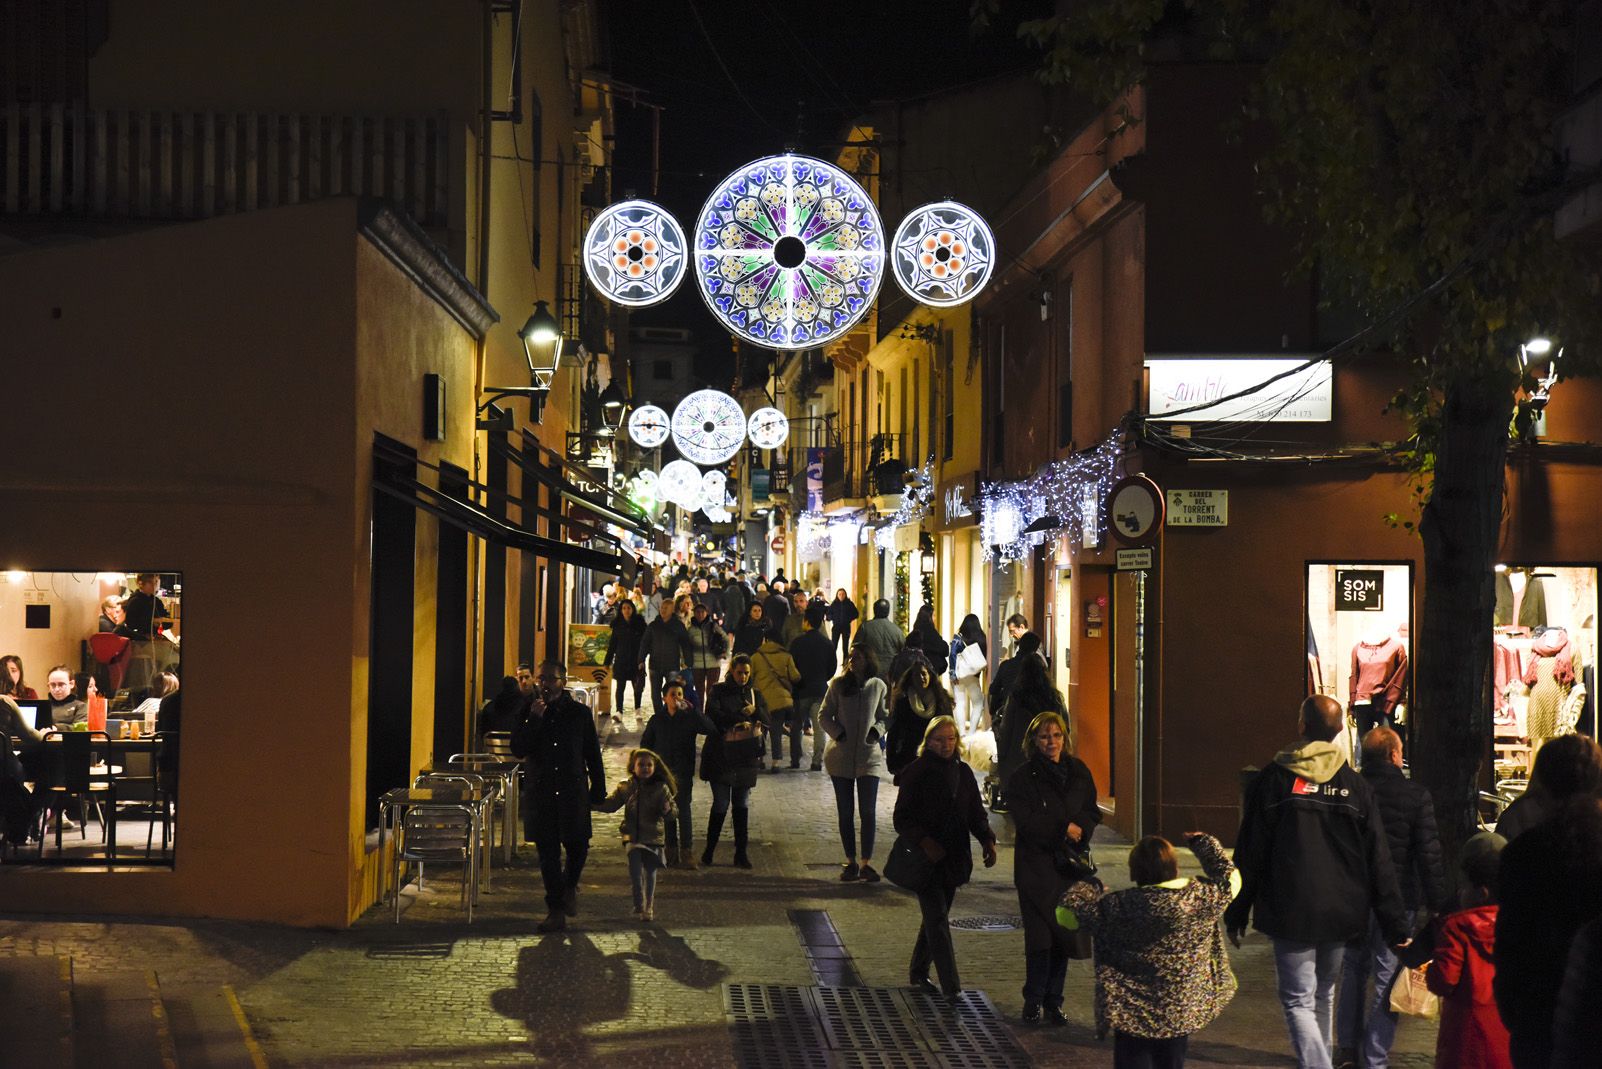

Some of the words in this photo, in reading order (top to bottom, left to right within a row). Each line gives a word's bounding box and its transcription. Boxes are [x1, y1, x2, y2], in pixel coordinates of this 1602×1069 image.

[1183, 505, 1216, 514] TORRENT
[1197, 515, 1220, 523] BOMBA
[1343, 580, 1376, 591] SOM
[1343, 590, 1367, 601] SIS
